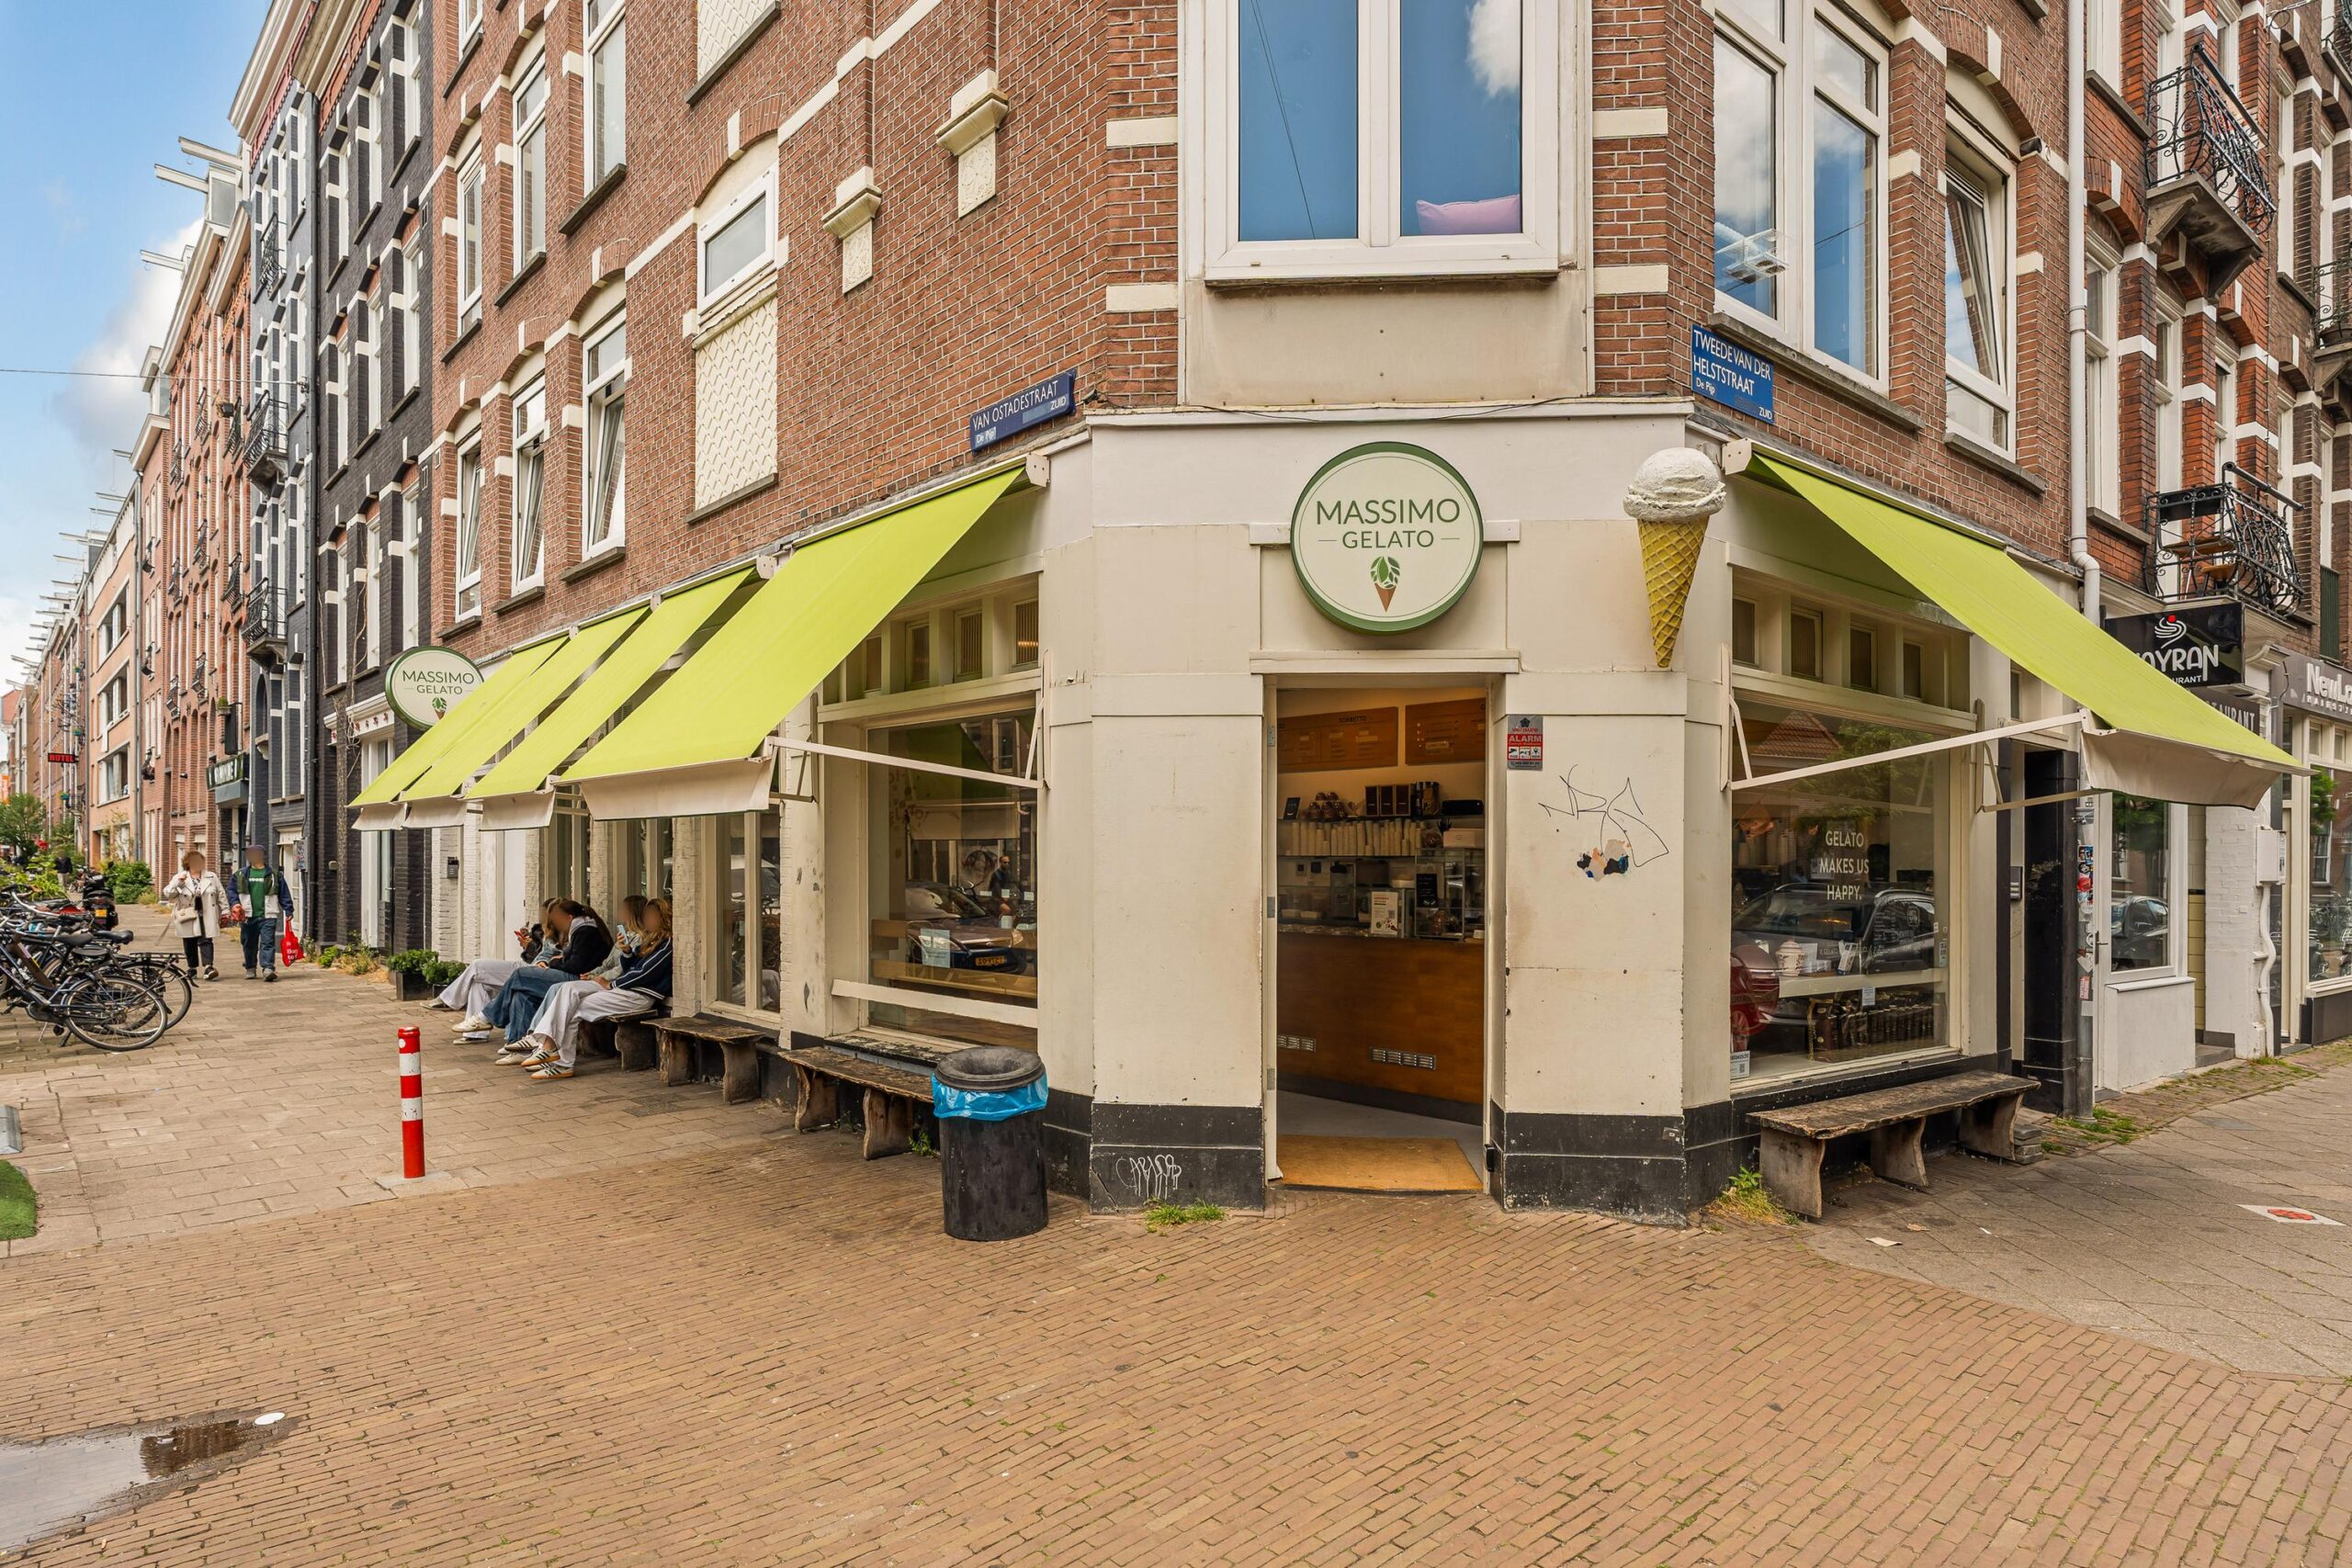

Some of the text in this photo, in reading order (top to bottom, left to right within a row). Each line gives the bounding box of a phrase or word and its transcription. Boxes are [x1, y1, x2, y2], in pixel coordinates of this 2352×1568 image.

[1693, 329, 1771, 381] TWEEDE VAN DER
[1693, 355, 1755, 396] HELSTSTRAAT
[1696, 378, 1704, 389] De
[972, 380, 1058, 432] VAN OSTADESTRAAT
[1050, 397, 1067, 411] ZUID
[1758, 407, 1772, 420] ZUID
[977, 434, 984, 444] De
[1317, 498, 1460, 525] MASSIMO
[1342, 530, 1434, 548] GELATO
[2137, 644, 2219, 682] YRAN
[402, 671, 474, 684] MASSIMO
[416, 684, 463, 694] GELATO
[1825, 830, 1864, 847] GELATO
[1819, 858, 1870, 874] MAKES US
[1826, 885, 1862, 900] HAPPY.
